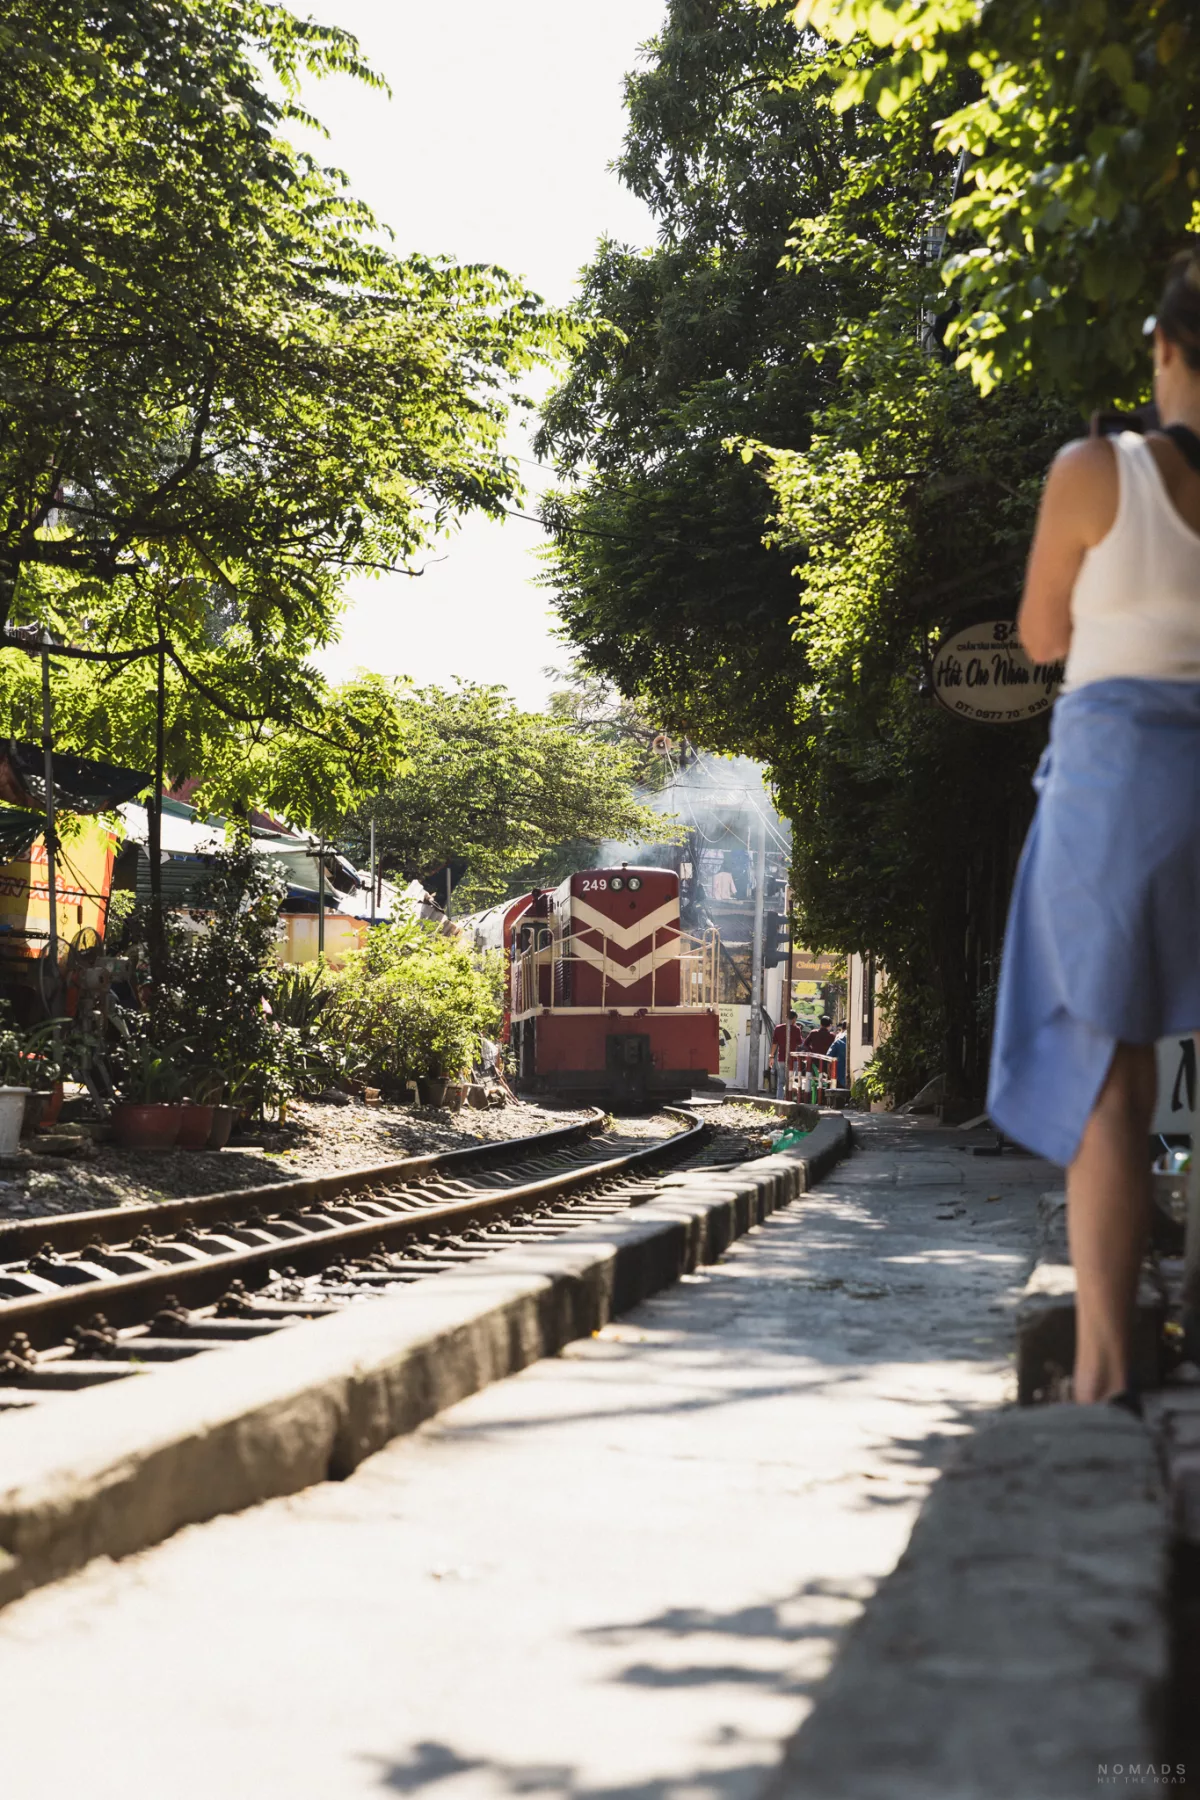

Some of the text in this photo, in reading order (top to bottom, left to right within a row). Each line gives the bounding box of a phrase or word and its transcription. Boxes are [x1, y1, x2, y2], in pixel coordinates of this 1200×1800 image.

[975, 709, 1003, 720] 0977
[1028, 699, 1049, 713] 930
[582, 879, 607, 891] 249
